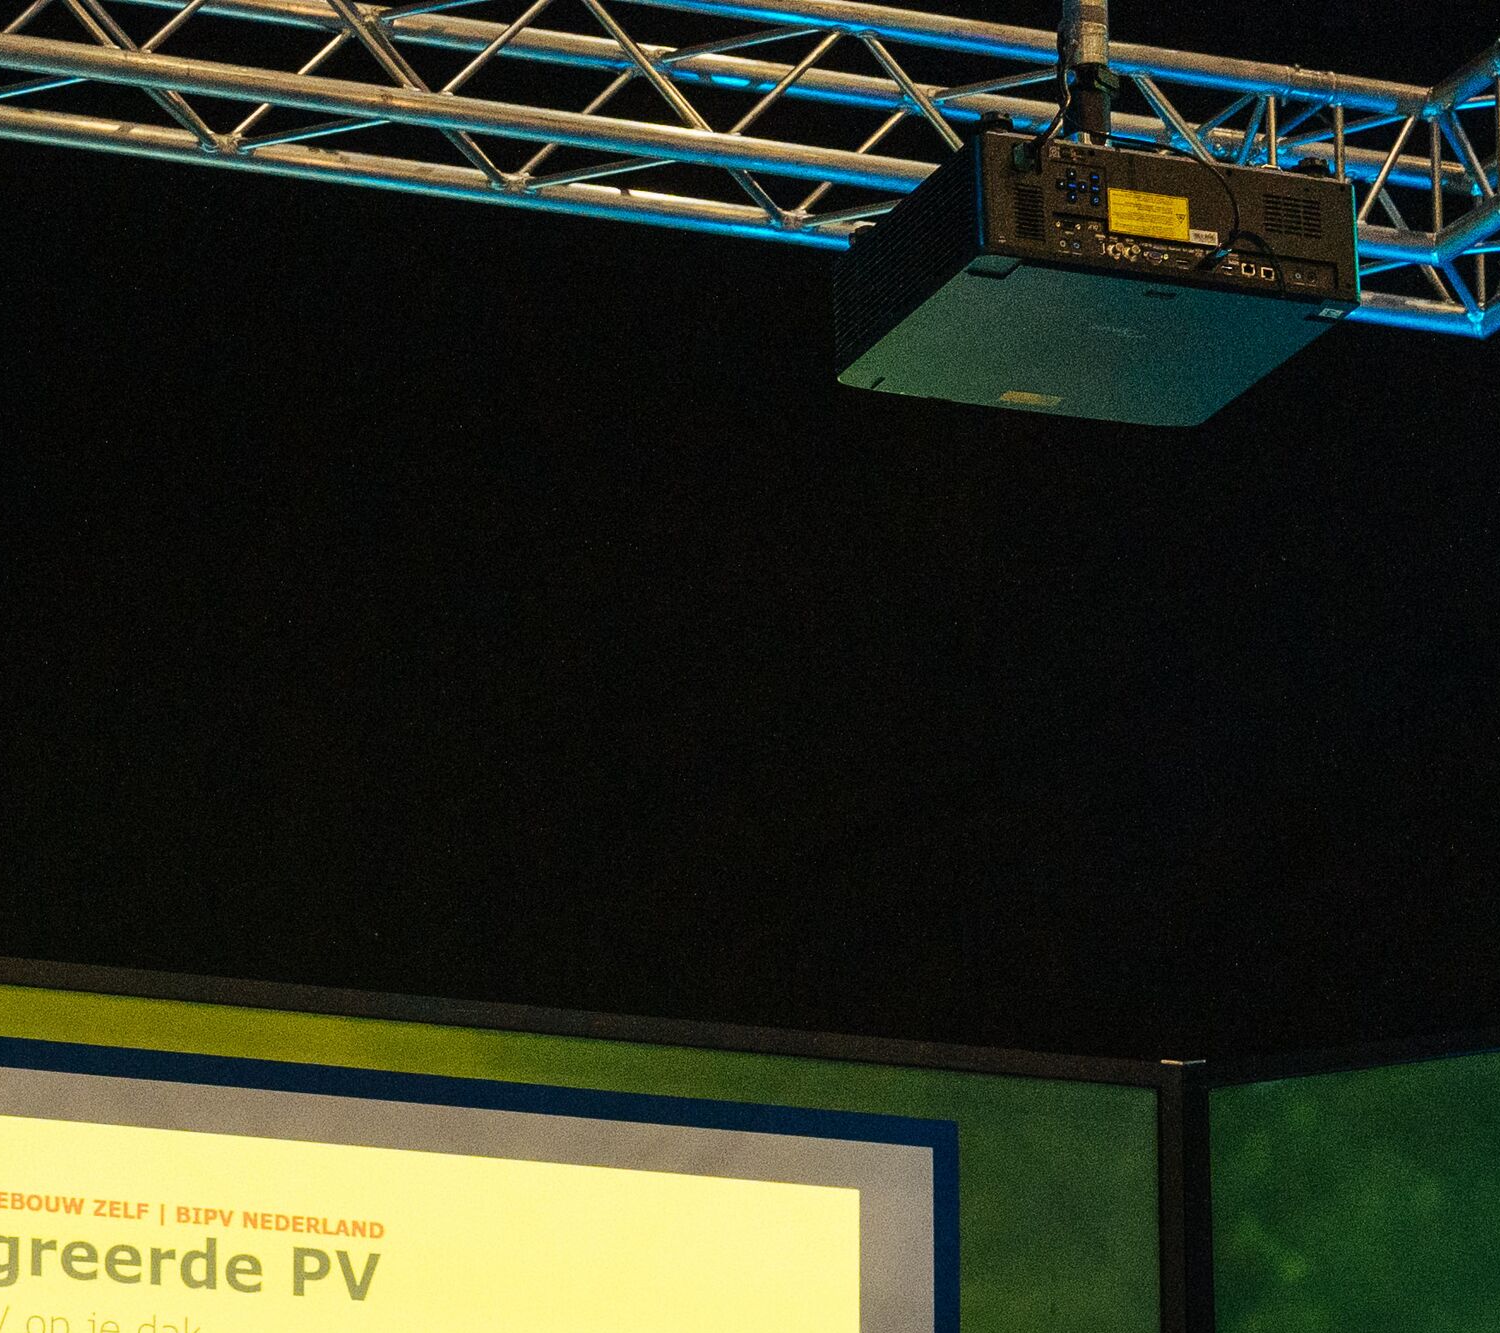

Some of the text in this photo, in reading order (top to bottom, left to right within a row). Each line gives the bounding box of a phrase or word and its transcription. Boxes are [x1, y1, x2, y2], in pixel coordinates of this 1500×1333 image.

[92, 1199, 150, 1220] ZELF
[175, 1205, 235, 1228] BIPV
[242, 1211, 386, 1240] NEDERLAND
[292, 1246, 381, 1301] PV
